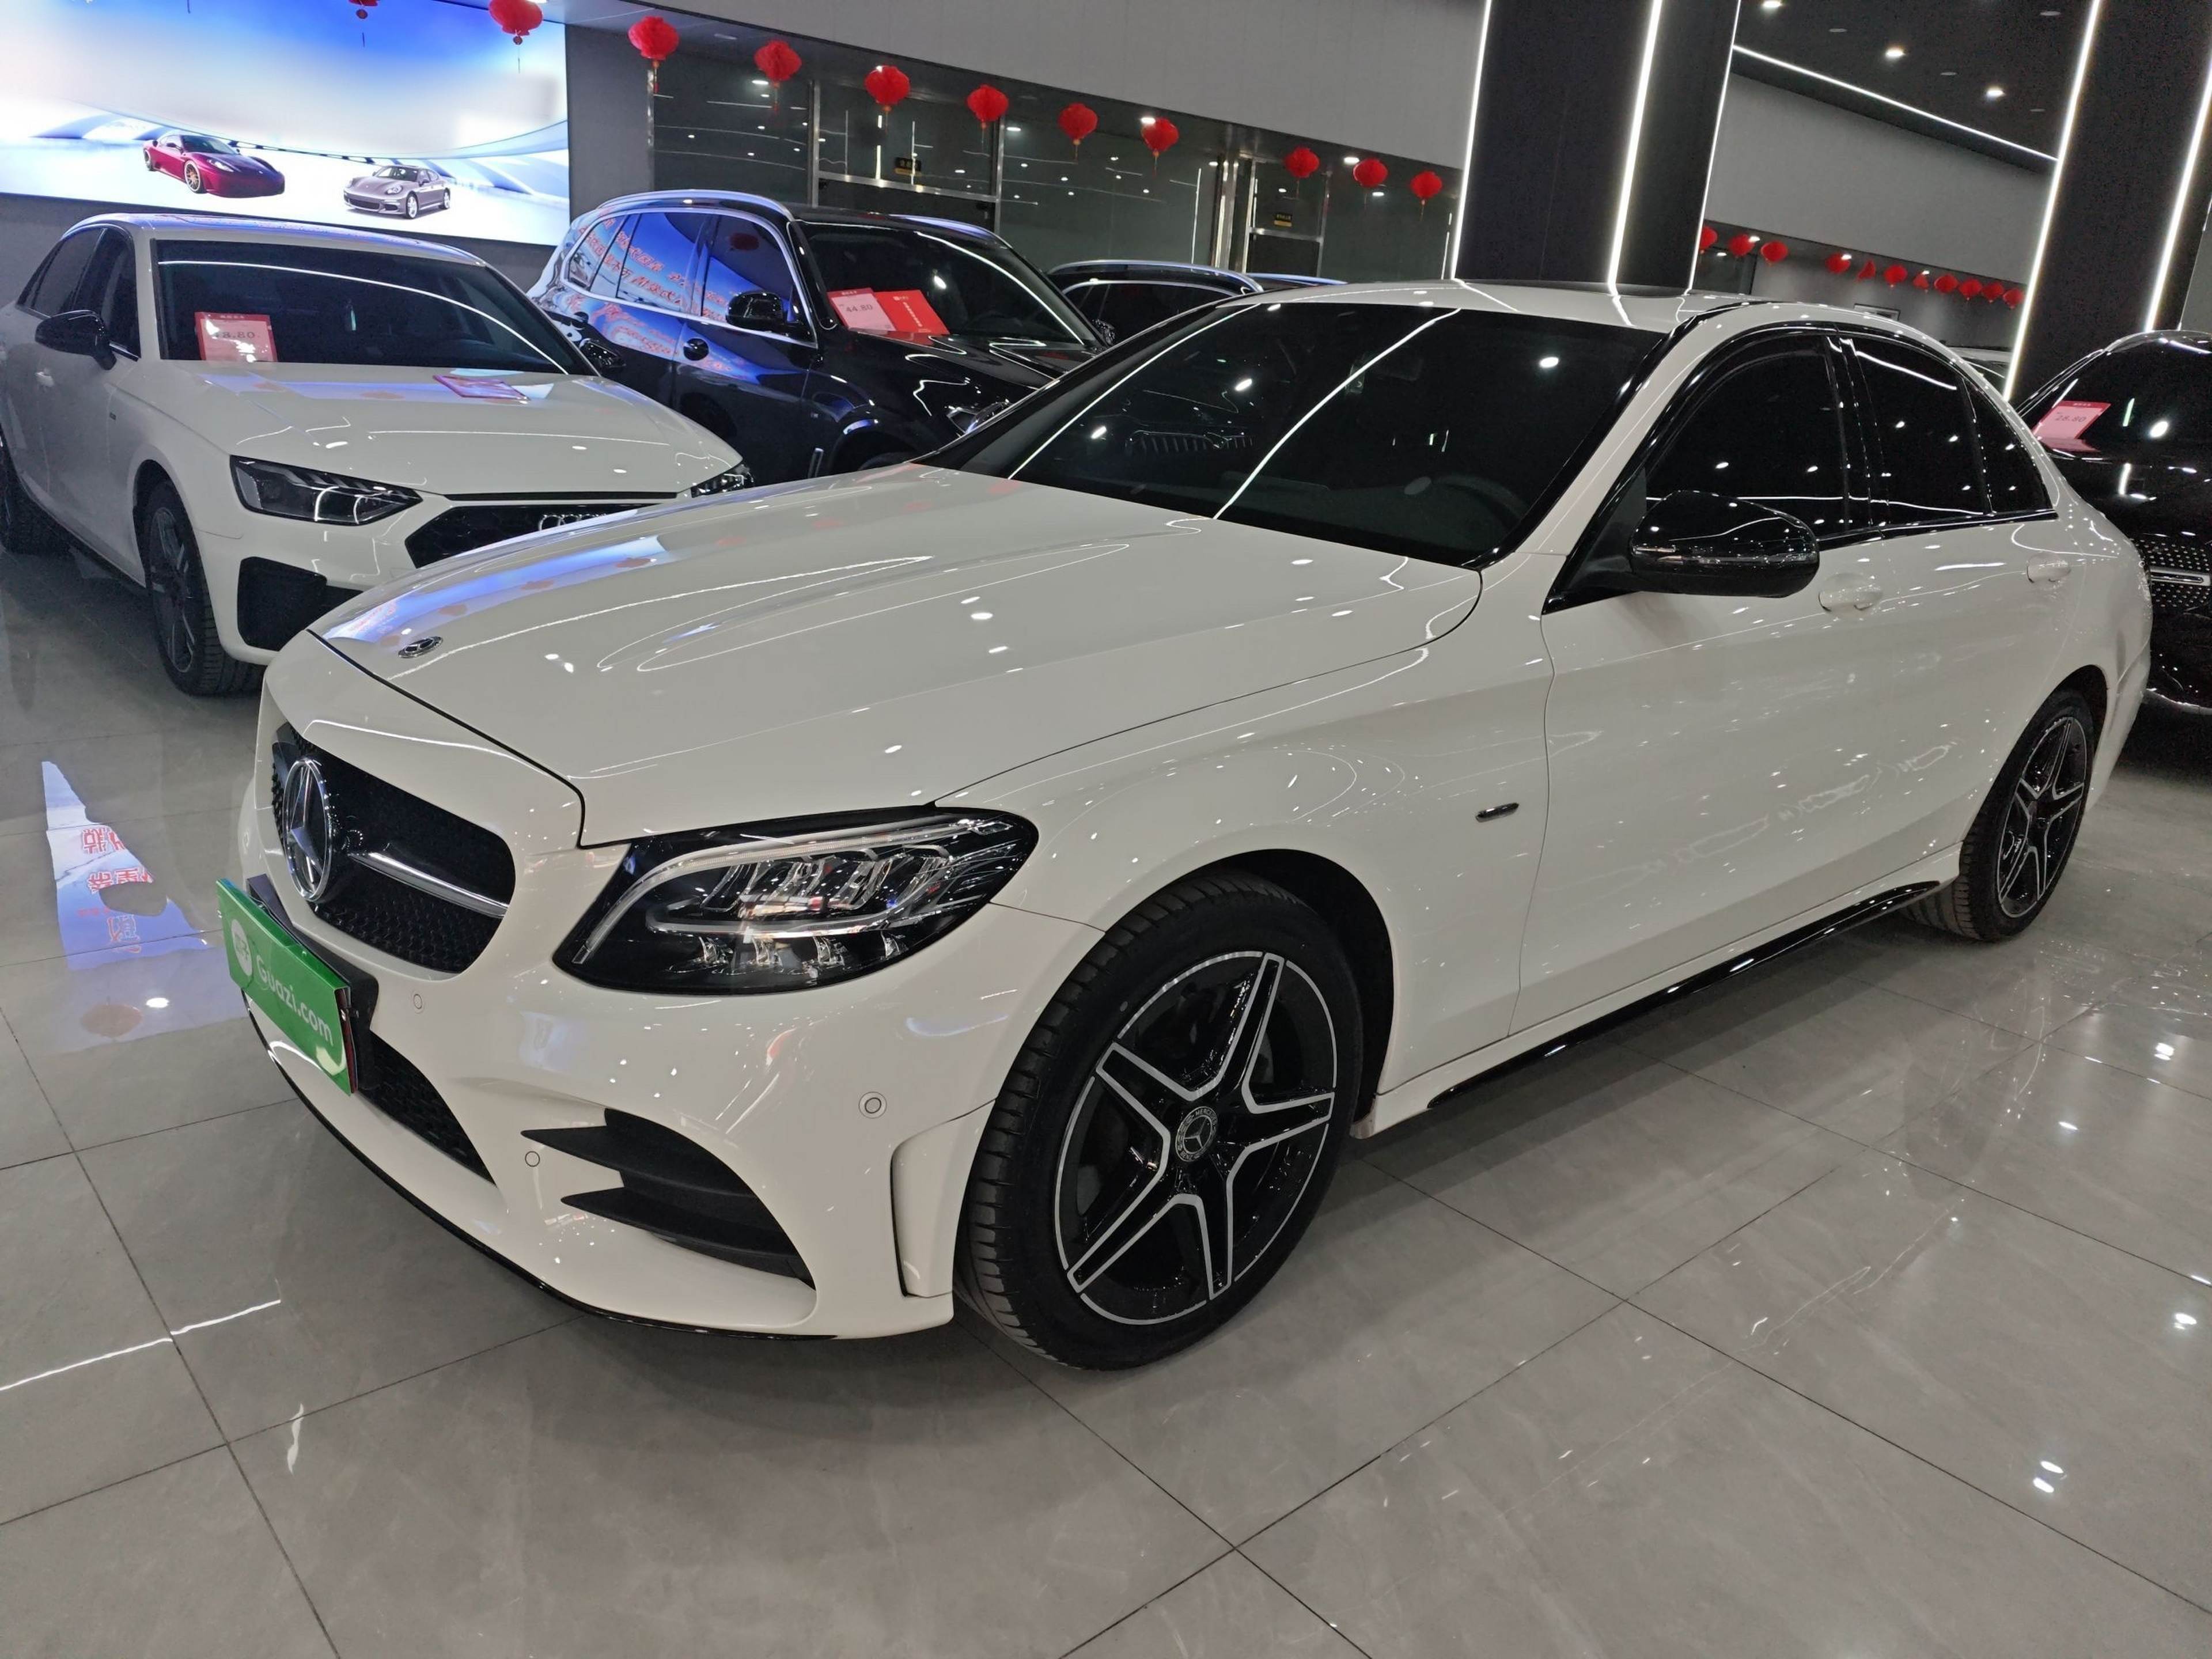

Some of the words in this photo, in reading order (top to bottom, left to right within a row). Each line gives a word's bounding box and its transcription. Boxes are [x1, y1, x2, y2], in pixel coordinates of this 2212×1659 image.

[256, 955, 334, 1047] Guazi.com
[1195, 1108, 1218, 1124] MERCEDES
[1180, 1150, 1194, 1160] BENZ
